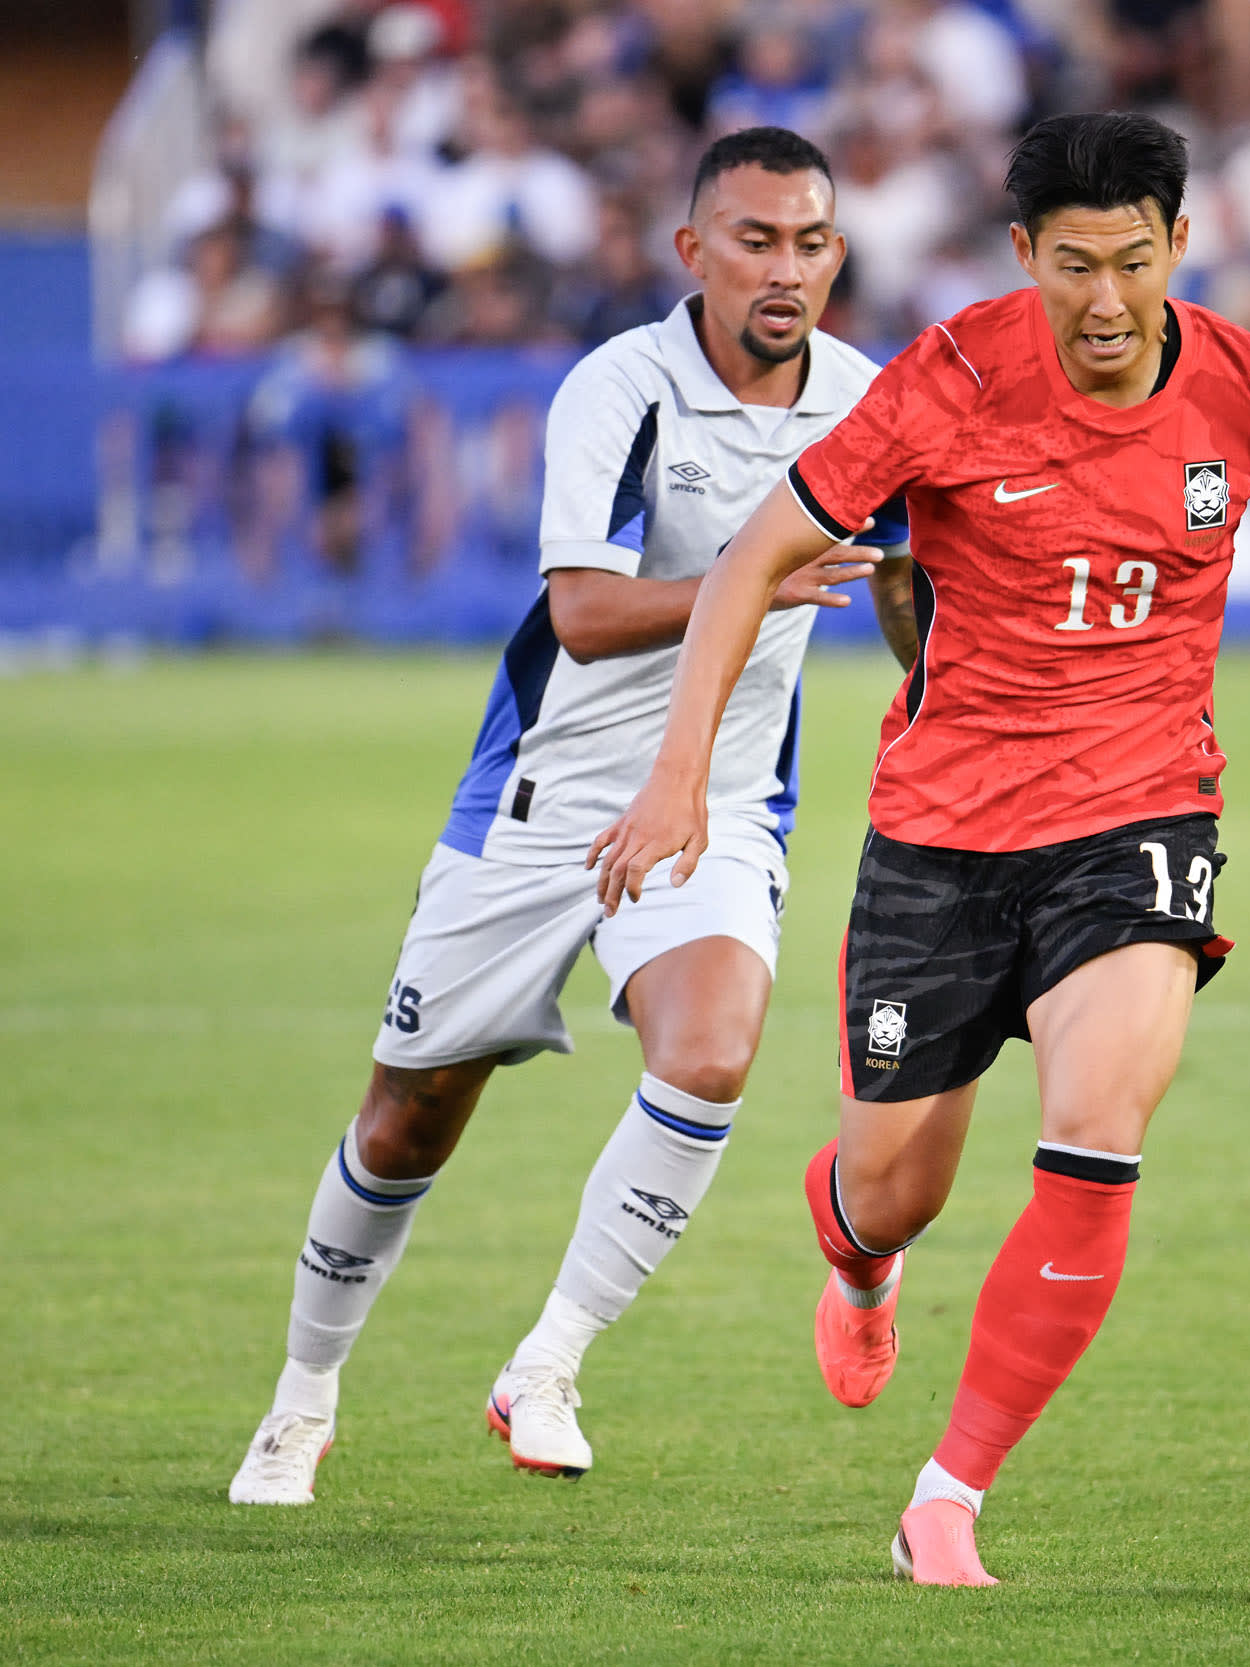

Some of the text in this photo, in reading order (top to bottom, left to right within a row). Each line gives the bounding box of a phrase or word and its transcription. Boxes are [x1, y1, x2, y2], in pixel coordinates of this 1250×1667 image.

[1054, 558, 1158, 630] 13
[1140, 842, 1212, 924] 13
[865, 1057, 900, 1070] KOREA
